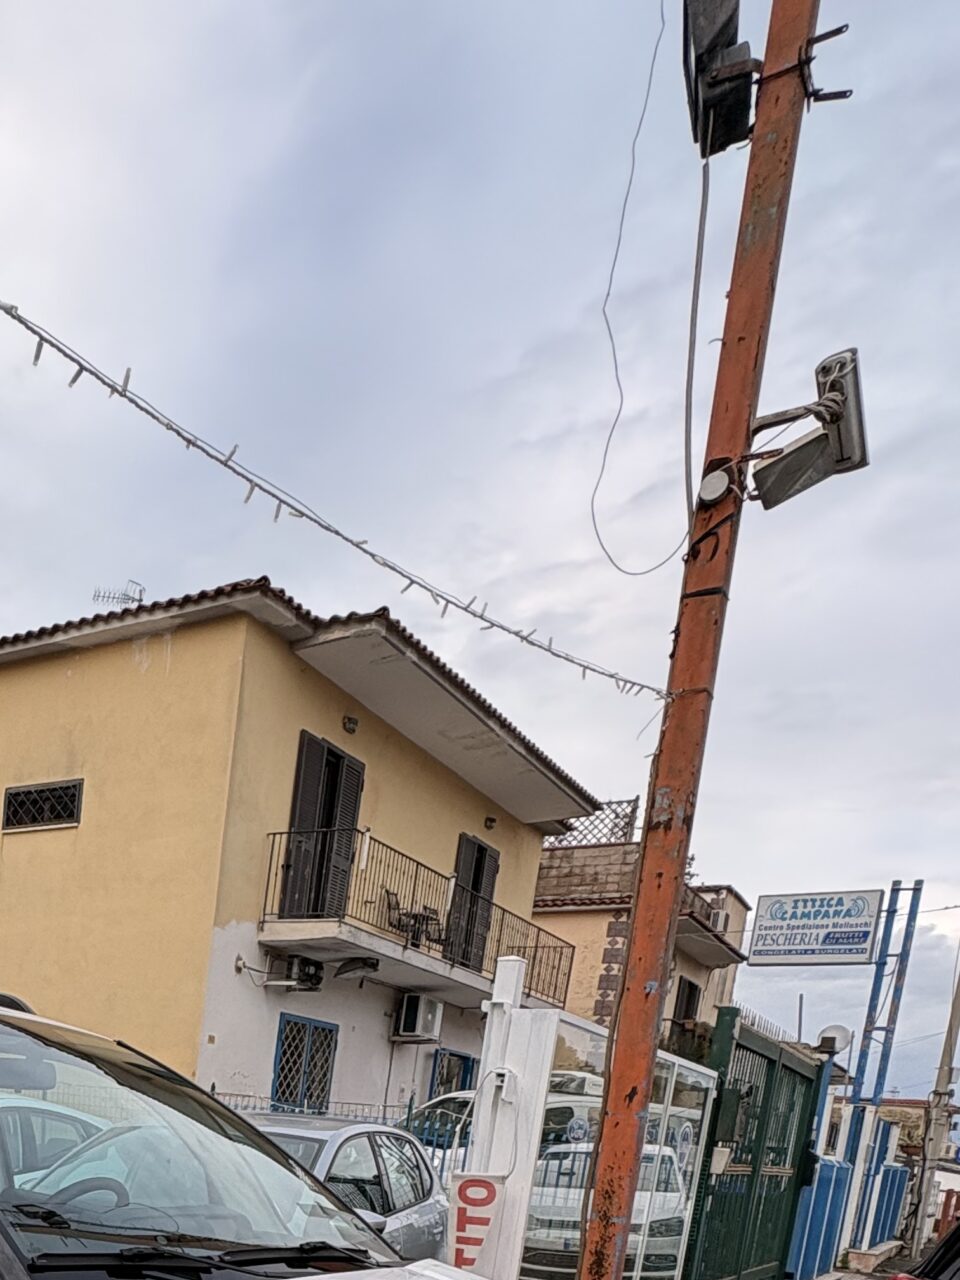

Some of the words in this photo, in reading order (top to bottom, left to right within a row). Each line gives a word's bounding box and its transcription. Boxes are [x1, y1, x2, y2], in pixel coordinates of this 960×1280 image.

[791, 897, 844, 909] ITTICA
[780, 908, 854, 921] CAMPANA
[785, 922, 829, 932] Spedizione
[831, 920, 872, 930] Molluschi
[754, 932, 820, 947] PESCHERIA
